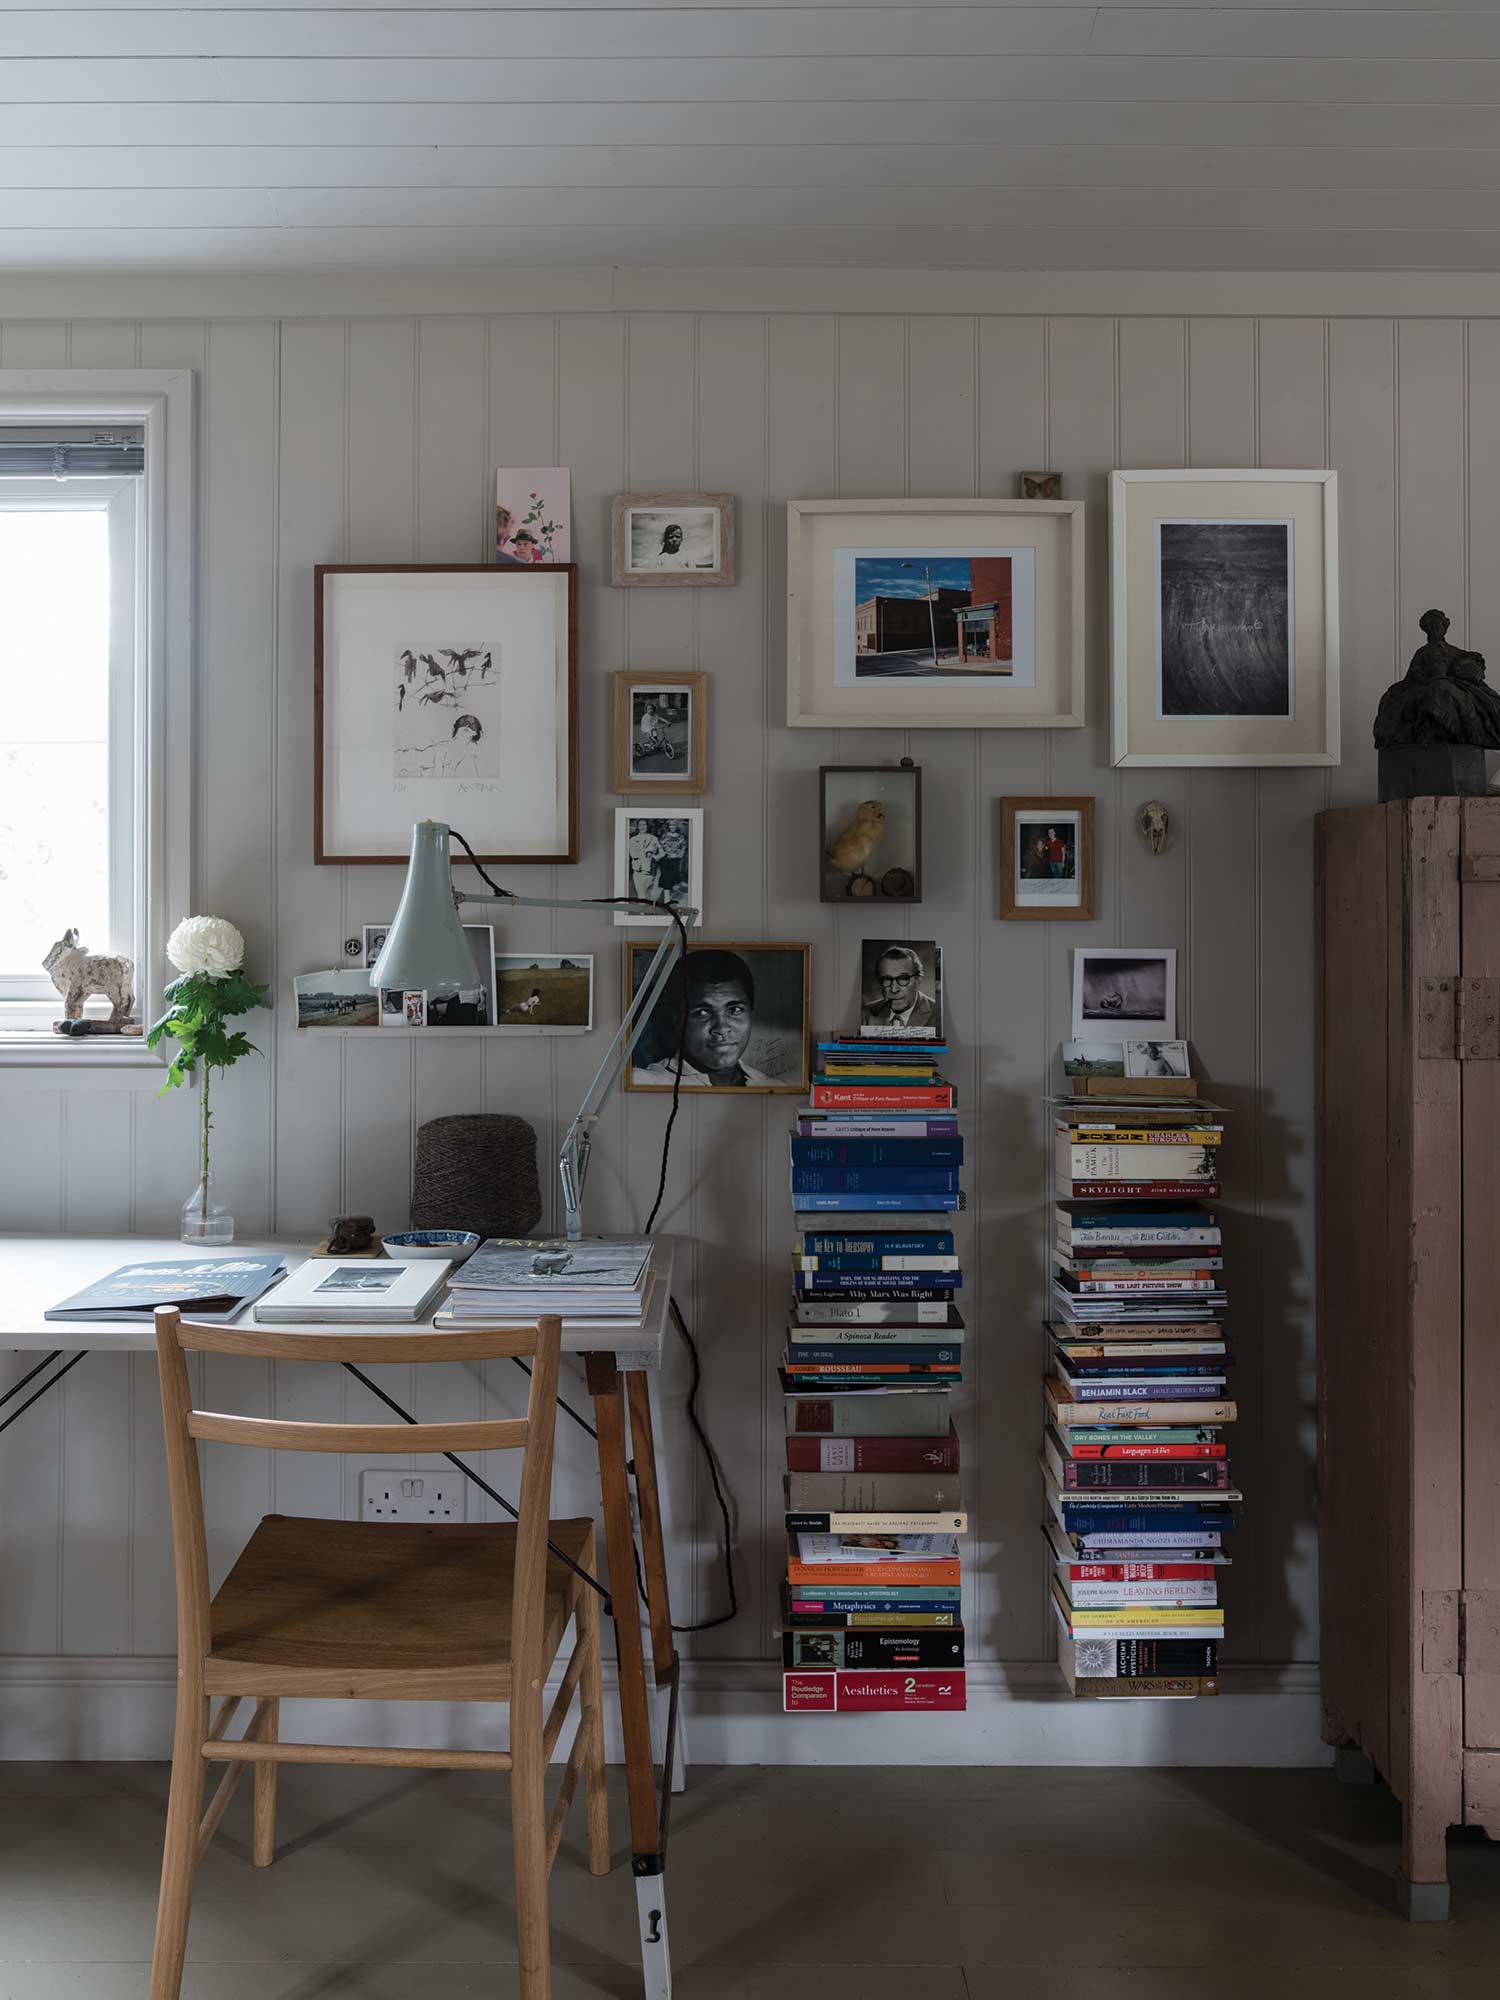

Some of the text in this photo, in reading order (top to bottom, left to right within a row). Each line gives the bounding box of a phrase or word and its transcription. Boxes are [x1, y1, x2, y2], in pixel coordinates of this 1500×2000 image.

[1077, 1132, 1143, 1141] WOMEN
[496, 1239, 549, 1248] TATE
[849, 1290, 933, 1300] Why Marx Was Right
[830, 1308, 854, 1318] Plato
[836, 1332, 897, 1341] A Spinoza Reader
[819, 1365, 862, 1373] ROUSSEAU
[1081, 1387, 1148, 1397] BENJAMIN BLACK
[1098, 1406, 1151, 1420] Real Fast Food
[1122, 1447, 1151, 1457] Languages
[1123, 1586, 1196, 1596] LEAVING BERLIN
[833, 1602, 876, 1611] Metaphysics
[791, 1685, 824, 1693] Routledge
[842, 1684, 899, 1696] Aesthetics
[1128, 1680, 1194, 1690] WARS ROSES
[791, 1692, 828, 1700] Companion
